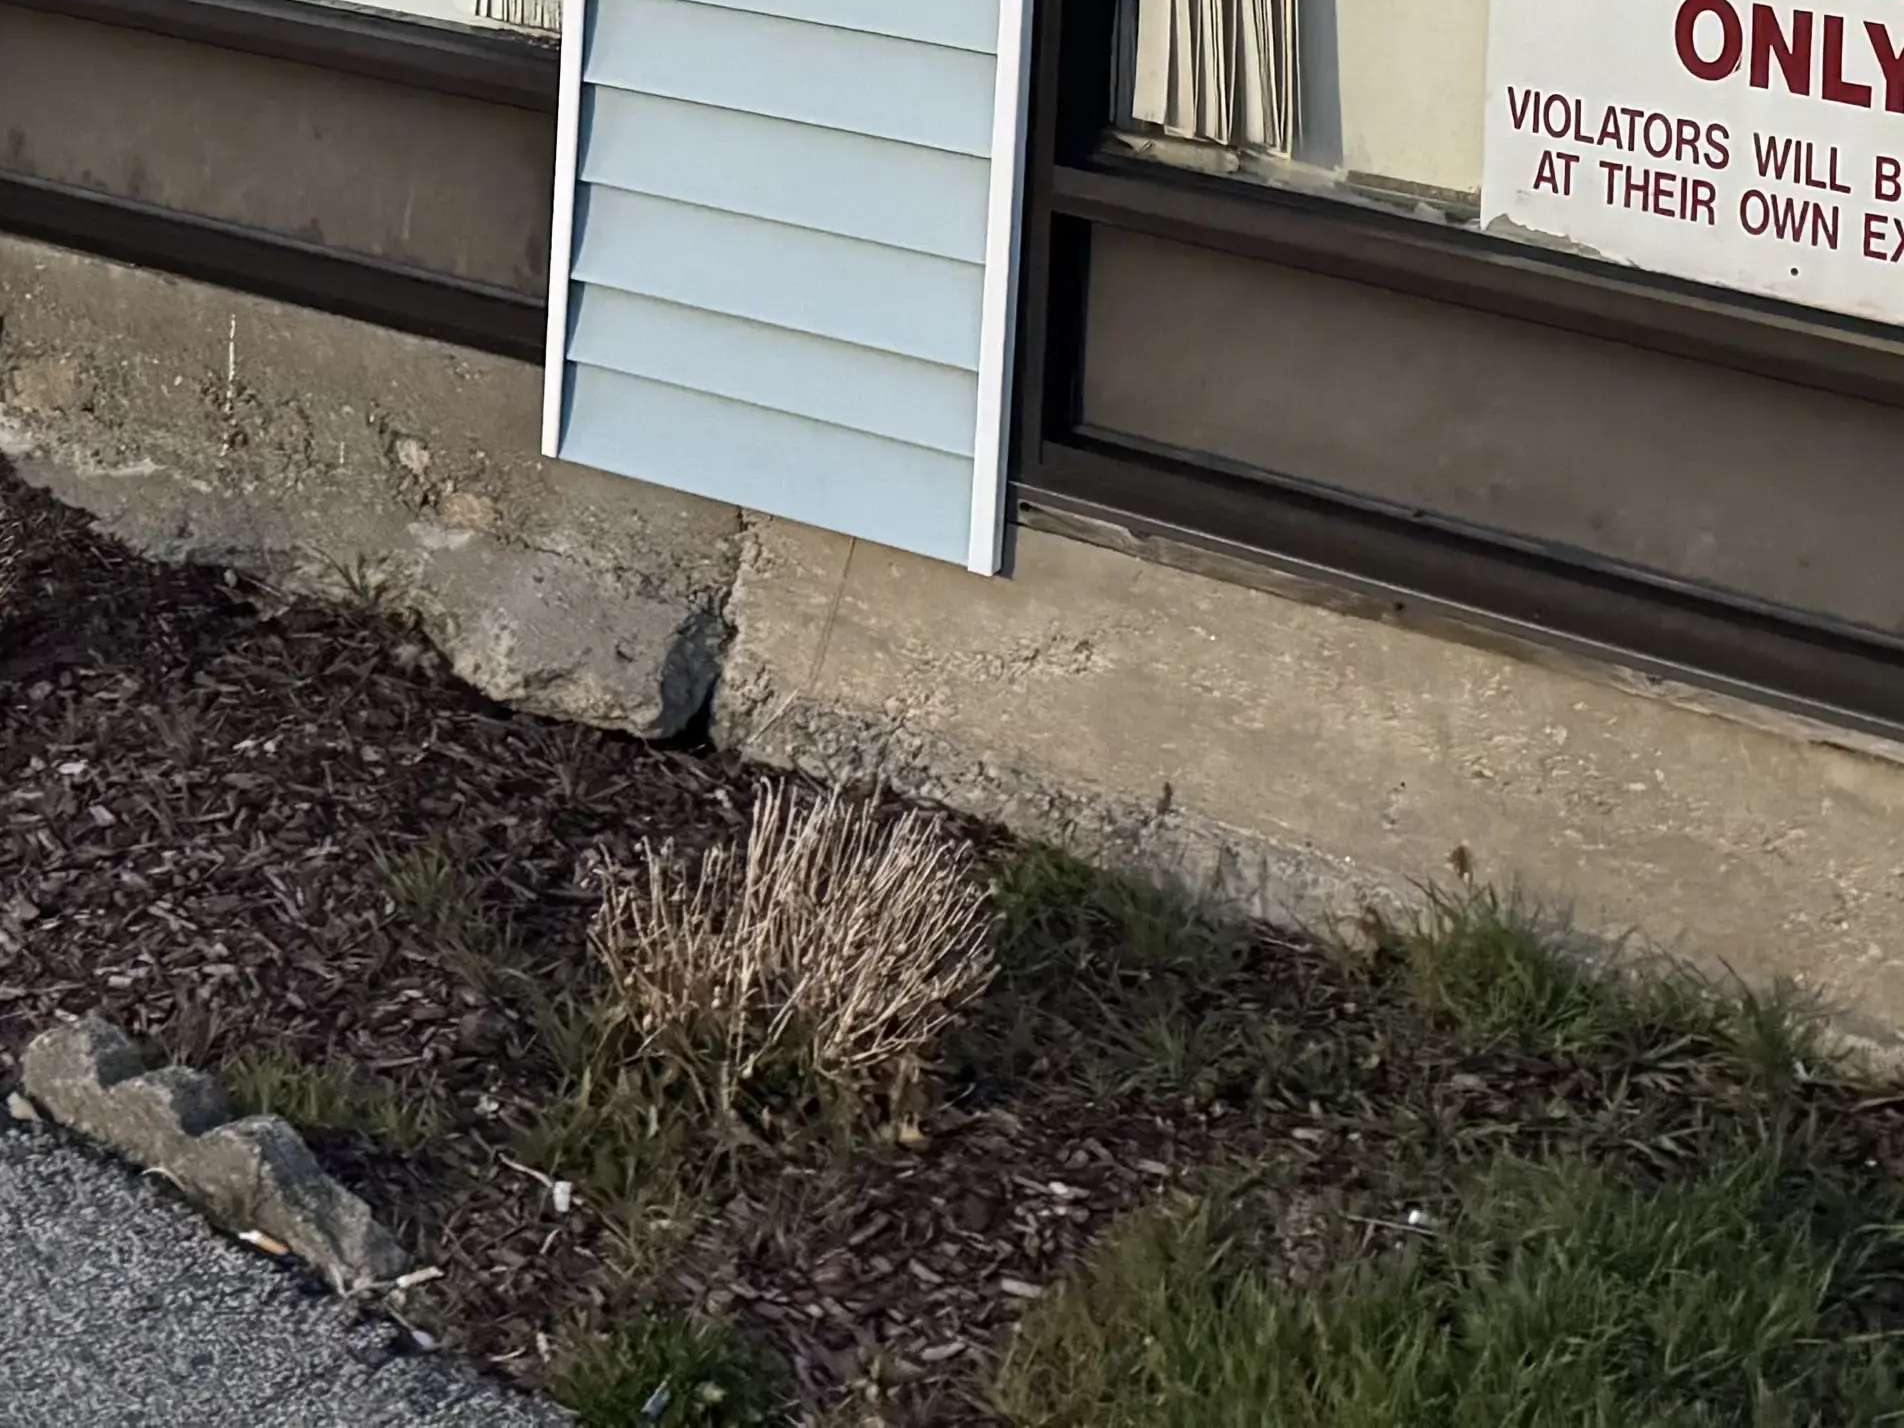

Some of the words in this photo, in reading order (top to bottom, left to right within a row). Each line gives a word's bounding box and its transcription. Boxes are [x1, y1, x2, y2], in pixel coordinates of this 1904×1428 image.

[1506, 85, 1731, 171] VIOLATORS
[1752, 132, 1852, 195] WILL
[1532, 150, 1575, 197] AT
[1599, 159, 1718, 227] THEIR
[1739, 190, 1839, 250] OWN
